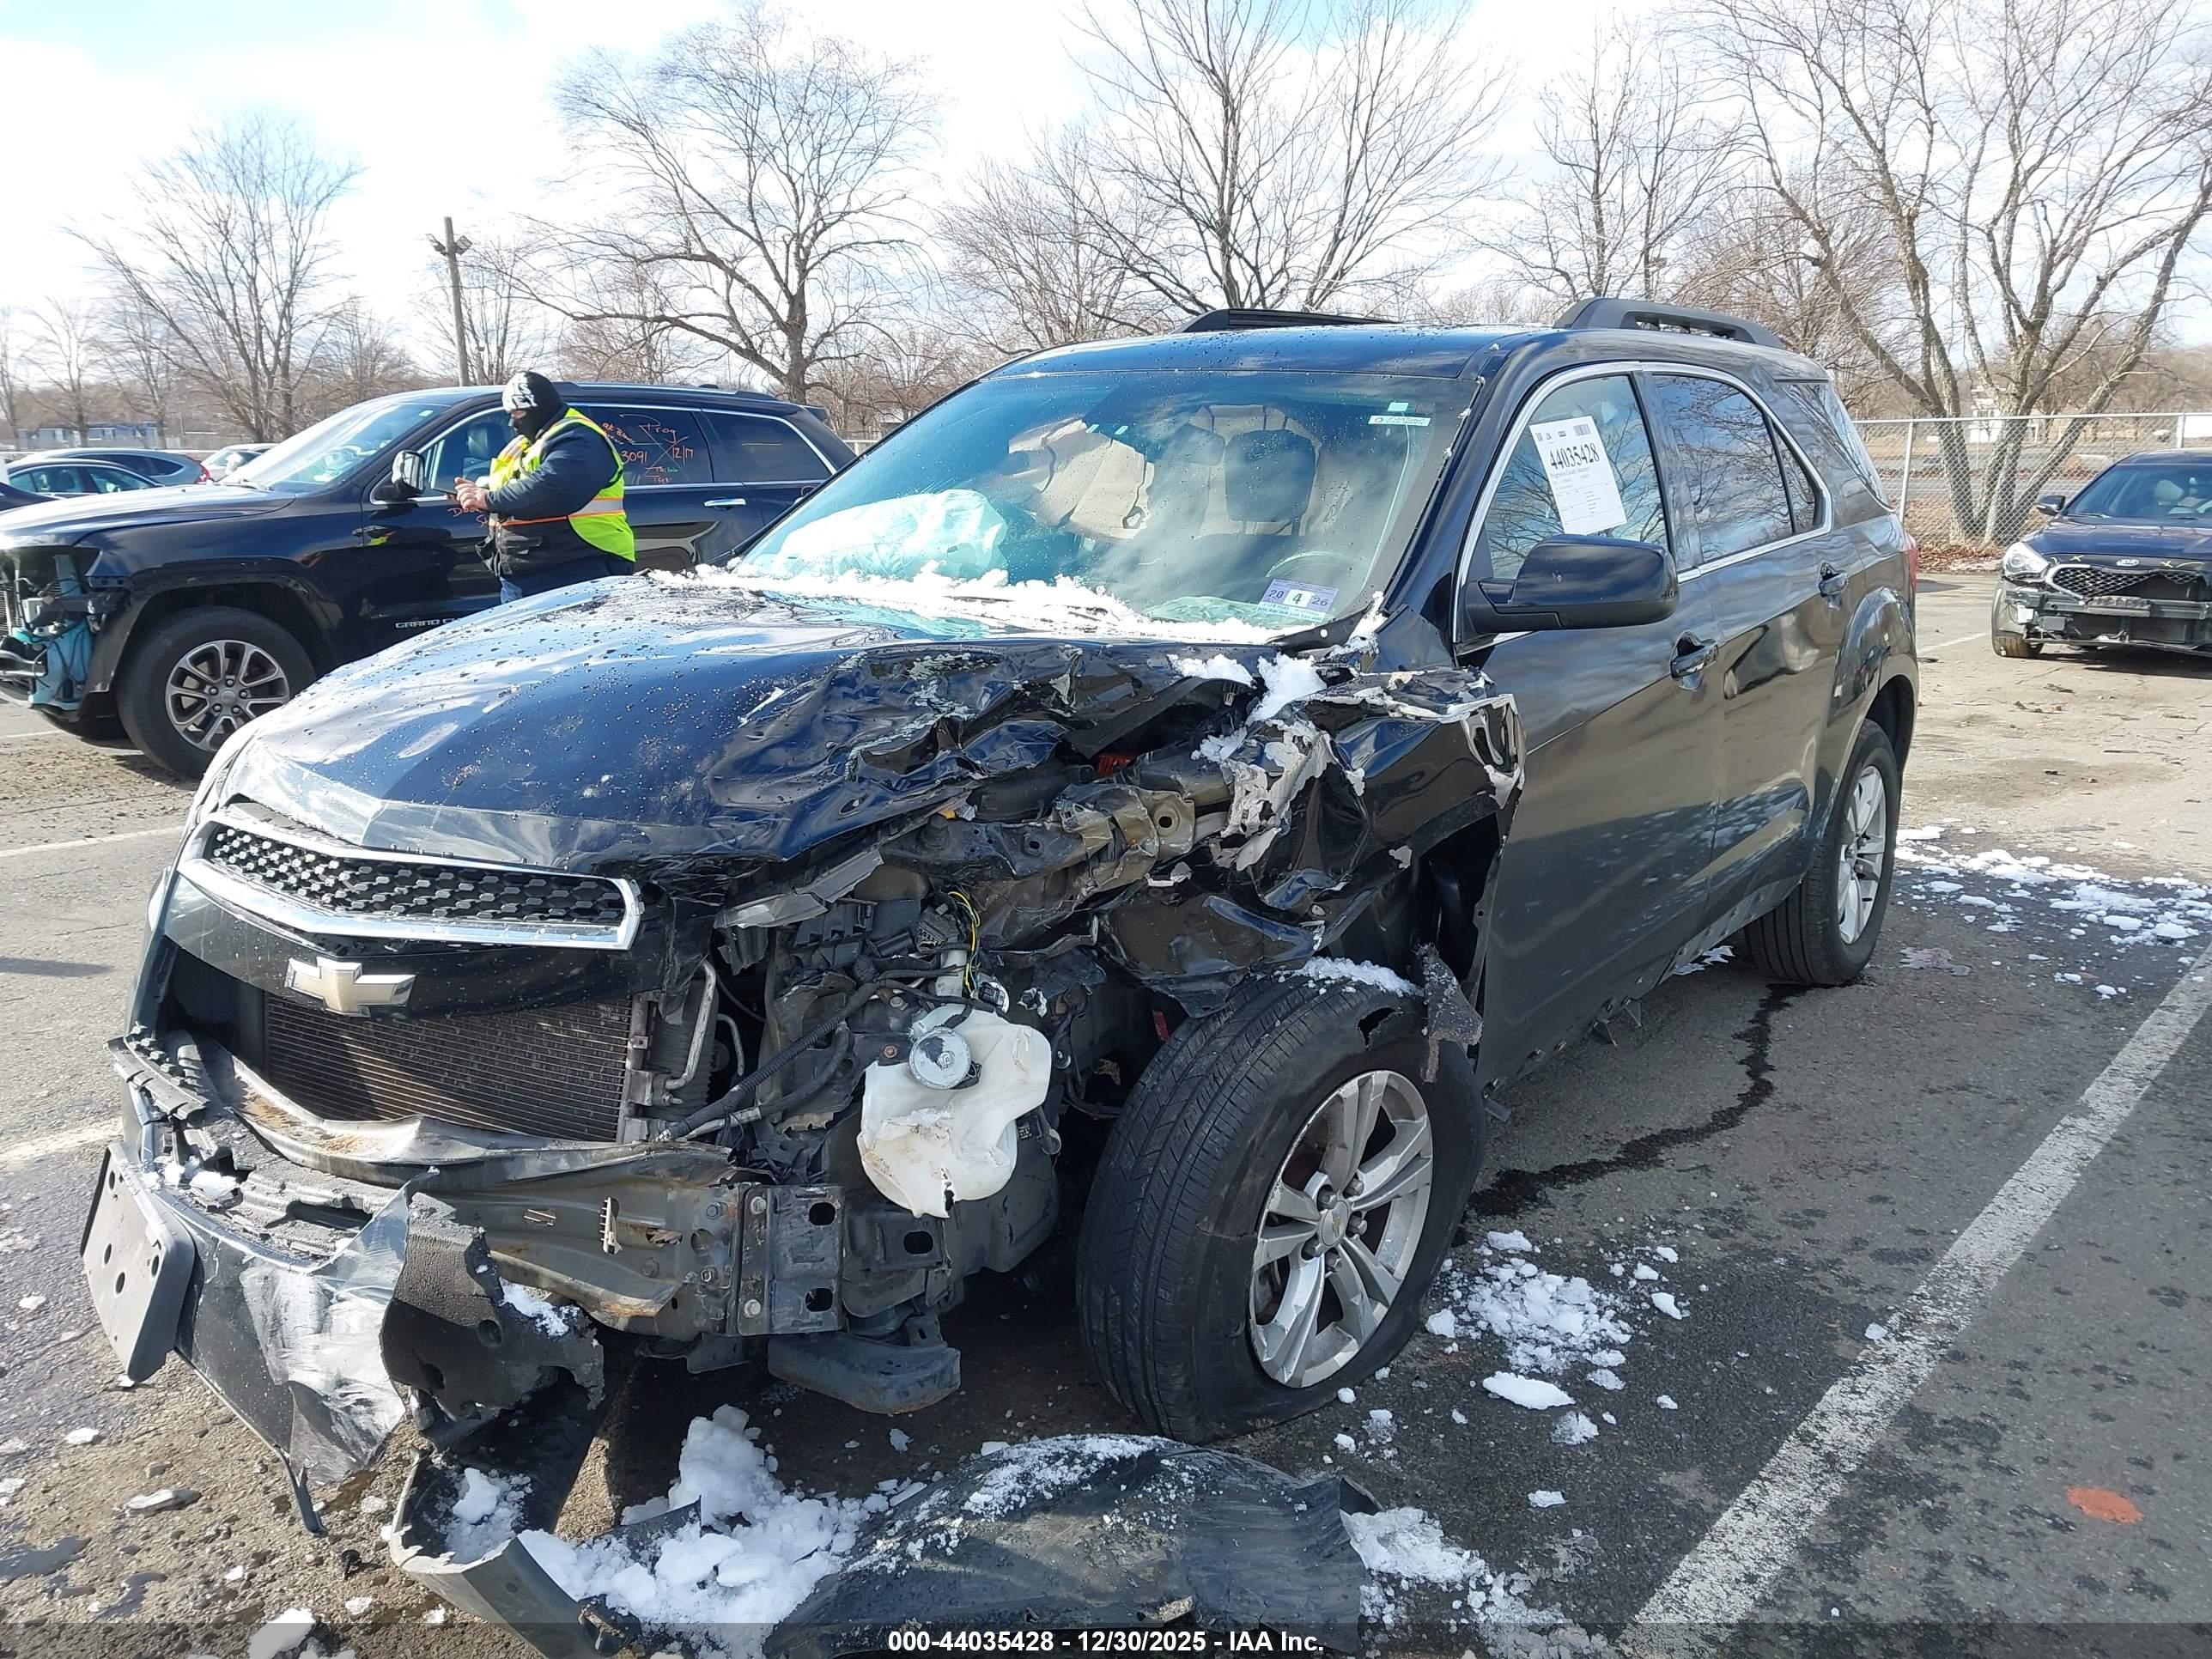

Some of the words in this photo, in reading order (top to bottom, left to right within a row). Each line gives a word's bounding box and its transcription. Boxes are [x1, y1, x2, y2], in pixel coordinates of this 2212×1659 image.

[1550, 442, 1600, 470] 44035428
[1268, 589, 1285, 599] 20
[1292, 592, 1304, 605] 4
[395, 619, 441, 629] GRAND
